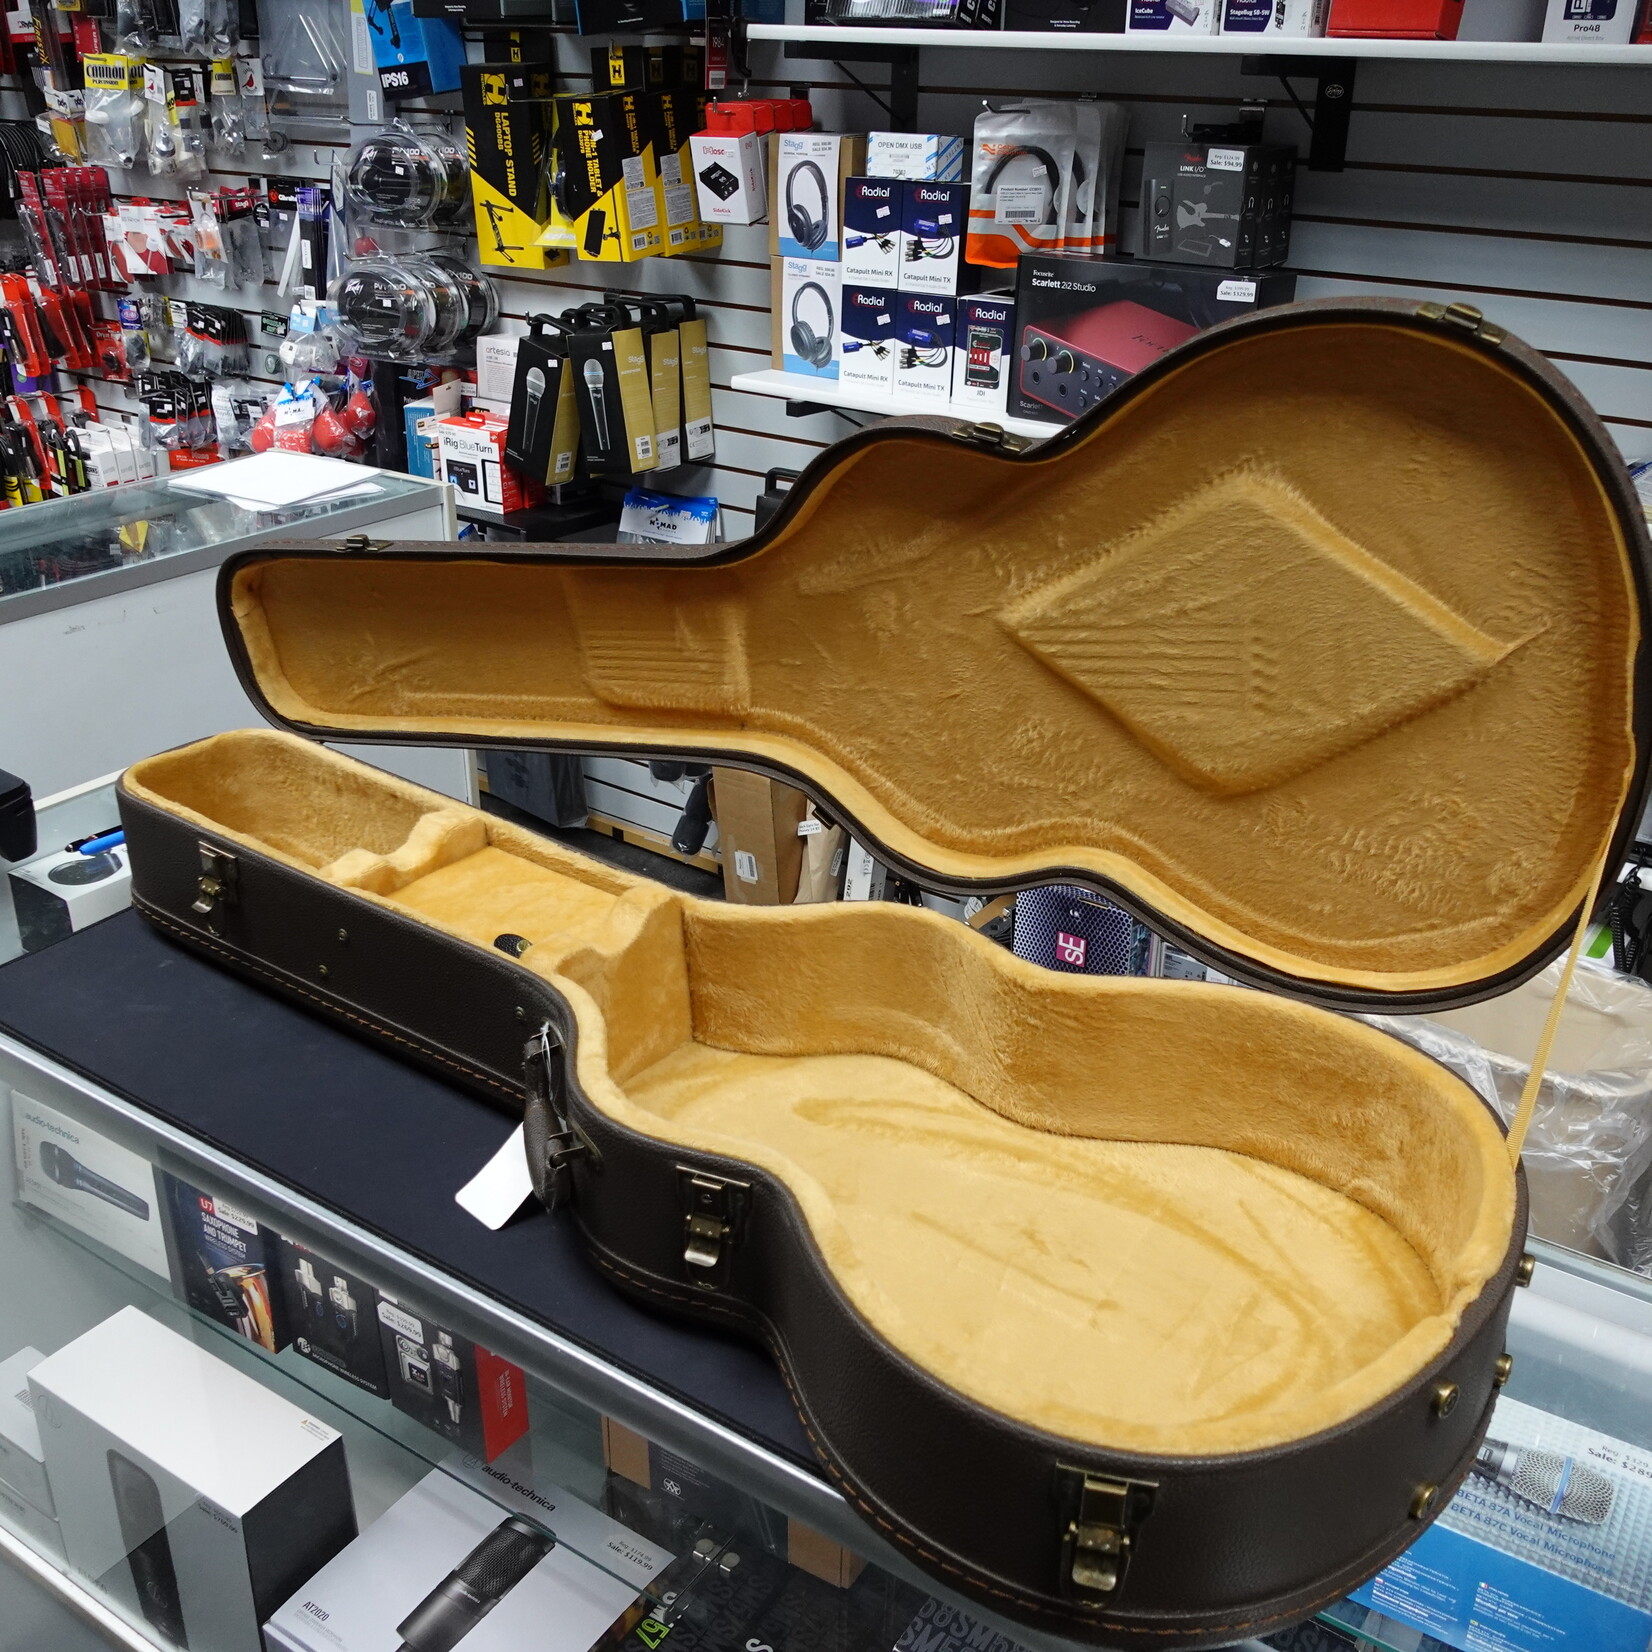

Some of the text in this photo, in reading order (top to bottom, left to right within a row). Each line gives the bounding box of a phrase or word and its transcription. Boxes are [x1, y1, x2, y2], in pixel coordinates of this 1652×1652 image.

[1573, 24, 1601, 32] Pro48
[380, 71, 410, 89] IPS16
[783, 139, 804, 151] Stagg
[877, 141, 895, 149] OPEN
[909, 142, 923, 150] USB
[500, 111, 517, 197] LAPTOP STAND
[582, 129, 597, 193] PHONE HOLDER
[1224, 160, 1243, 168] $94.99
[591, 158, 603, 192] TABLET
[861, 185, 891, 198] Radial
[920, 189, 951, 201] Radial
[787, 261, 808, 273] Stagg
[846, 266, 894, 277] Catapult Mini RX
[903, 272, 928, 282] Catapult
[942, 276, 952, 284] TX
[1031, 278, 1097, 293] Scarlett 2i2 Studio
[857, 293, 886, 307] Radial
[913, 300, 944, 313] Radial
[975, 307, 1007, 321] Radial
[485, 346, 511, 357] artesia
[843, 370, 889, 383] Catapult Mini RX
[898, 379, 945, 391] Catapult Mini TX
[443, 436, 459, 450] iRig
[24, 1111, 80, 1145] audio-technica
[200, 1197, 213, 1211] U7
[201, 1211, 239, 1239] SAXOPHONE
[203, 1223, 247, 1253] AND TRUMPET
[1588, 1447, 1617, 1465] Sale:
[481, 1463, 557, 1512] audio-technica
[1456, 1489, 1616, 1561] BETA 87A Vocal Microphone
[1450, 1502, 1614, 1575] BETA 87C Vocal Microphone
[607, 1540, 654, 1571] Sale: $119.99
[301, 1600, 331, 1622] AT2020
